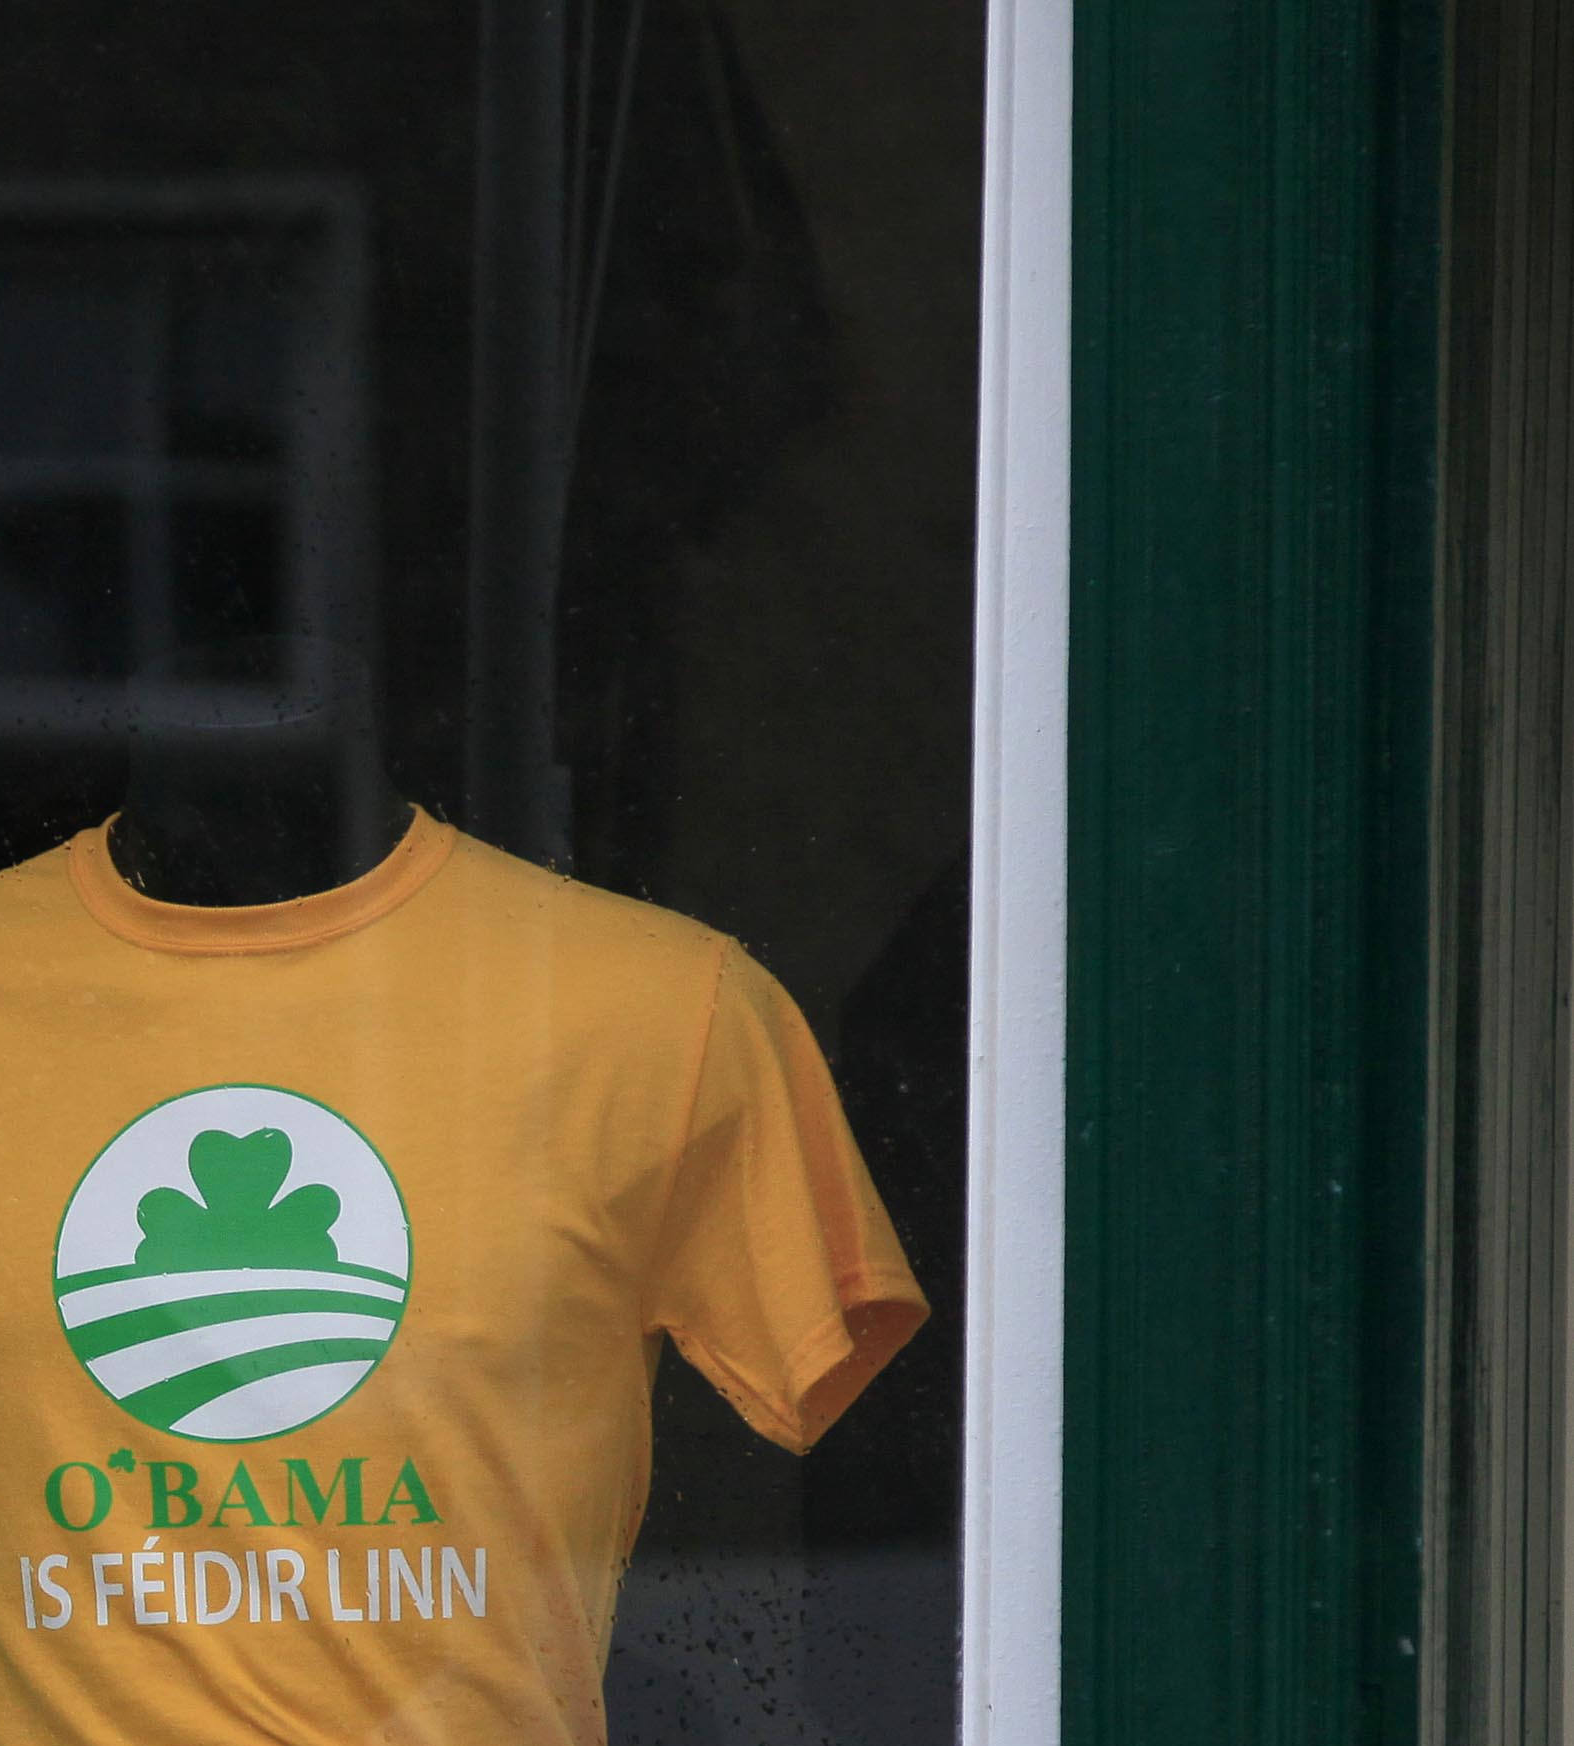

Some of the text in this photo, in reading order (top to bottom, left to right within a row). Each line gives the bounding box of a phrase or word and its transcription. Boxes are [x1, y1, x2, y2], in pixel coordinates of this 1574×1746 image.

[19, 1535, 488, 1630] IS FÉIDIR LINN
